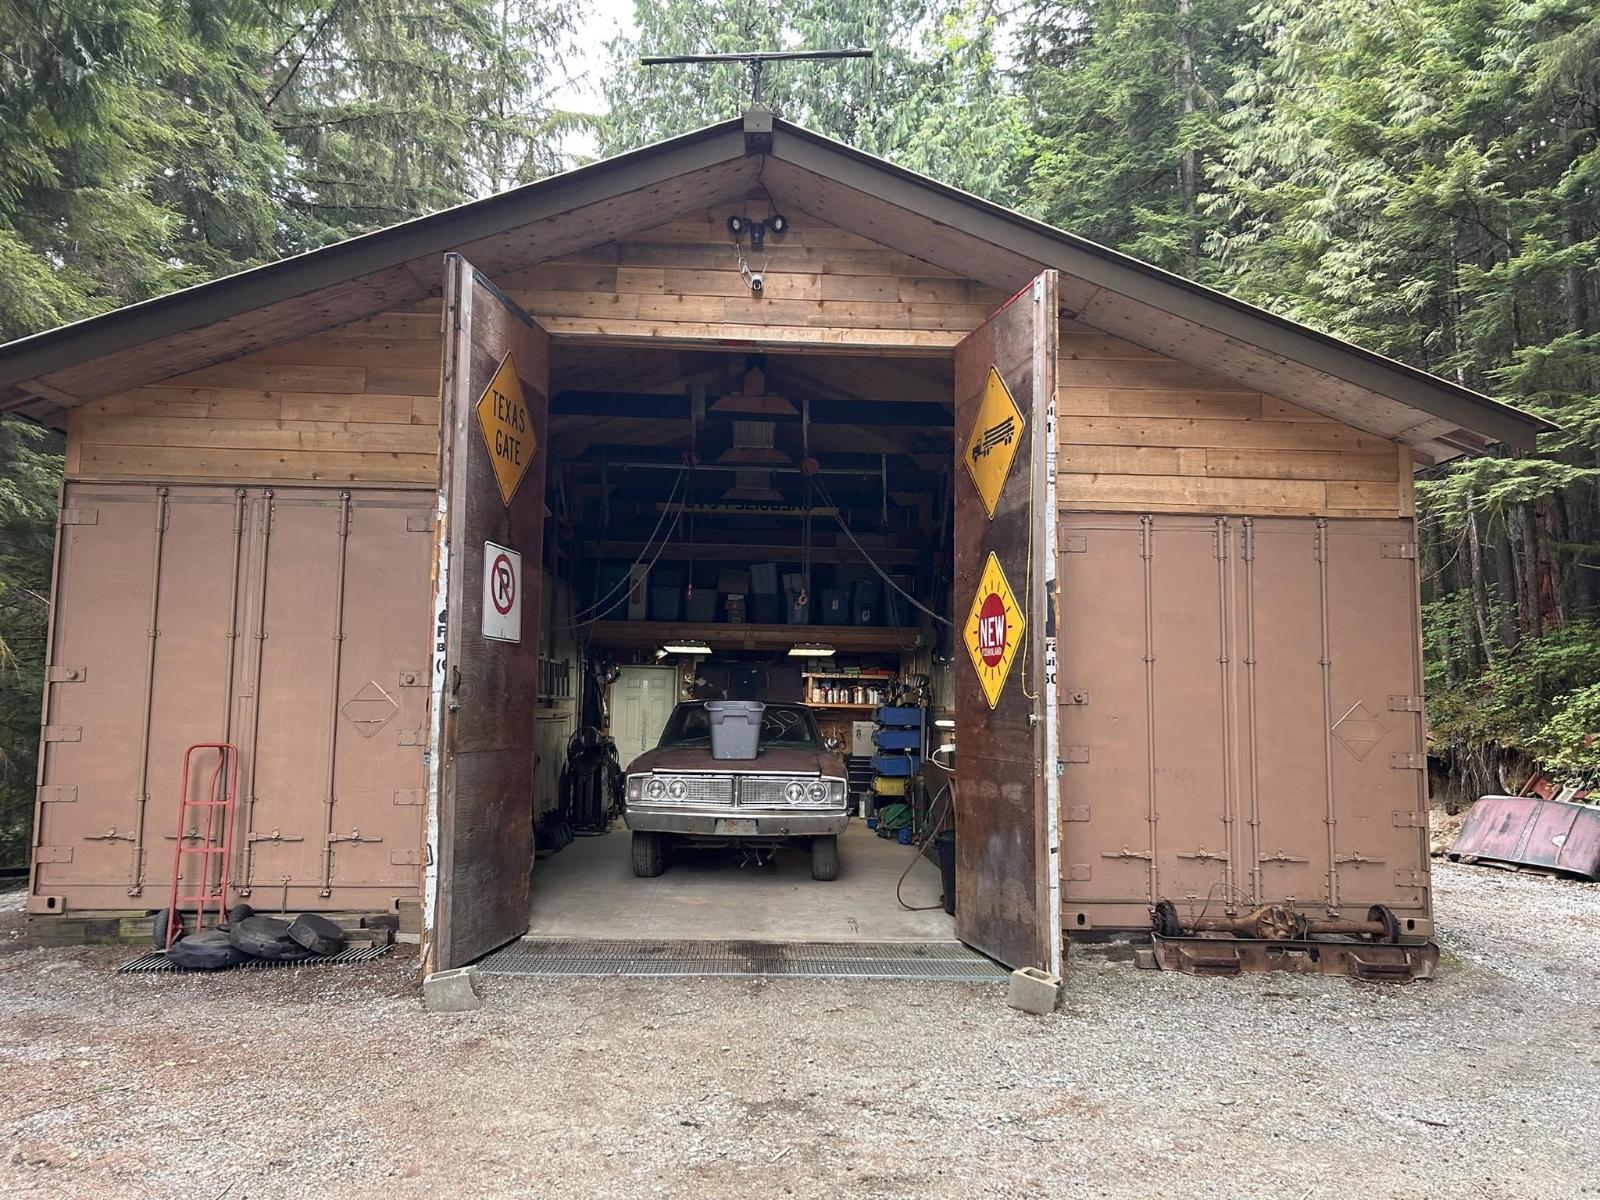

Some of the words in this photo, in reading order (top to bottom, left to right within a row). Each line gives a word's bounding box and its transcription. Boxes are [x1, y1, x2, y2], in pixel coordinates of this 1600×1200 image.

[492, 389, 525, 433] TEXAS
[495, 429, 521, 466] GATE
[499, 567, 510, 600] P
[980, 614, 1005, 648] NEW
